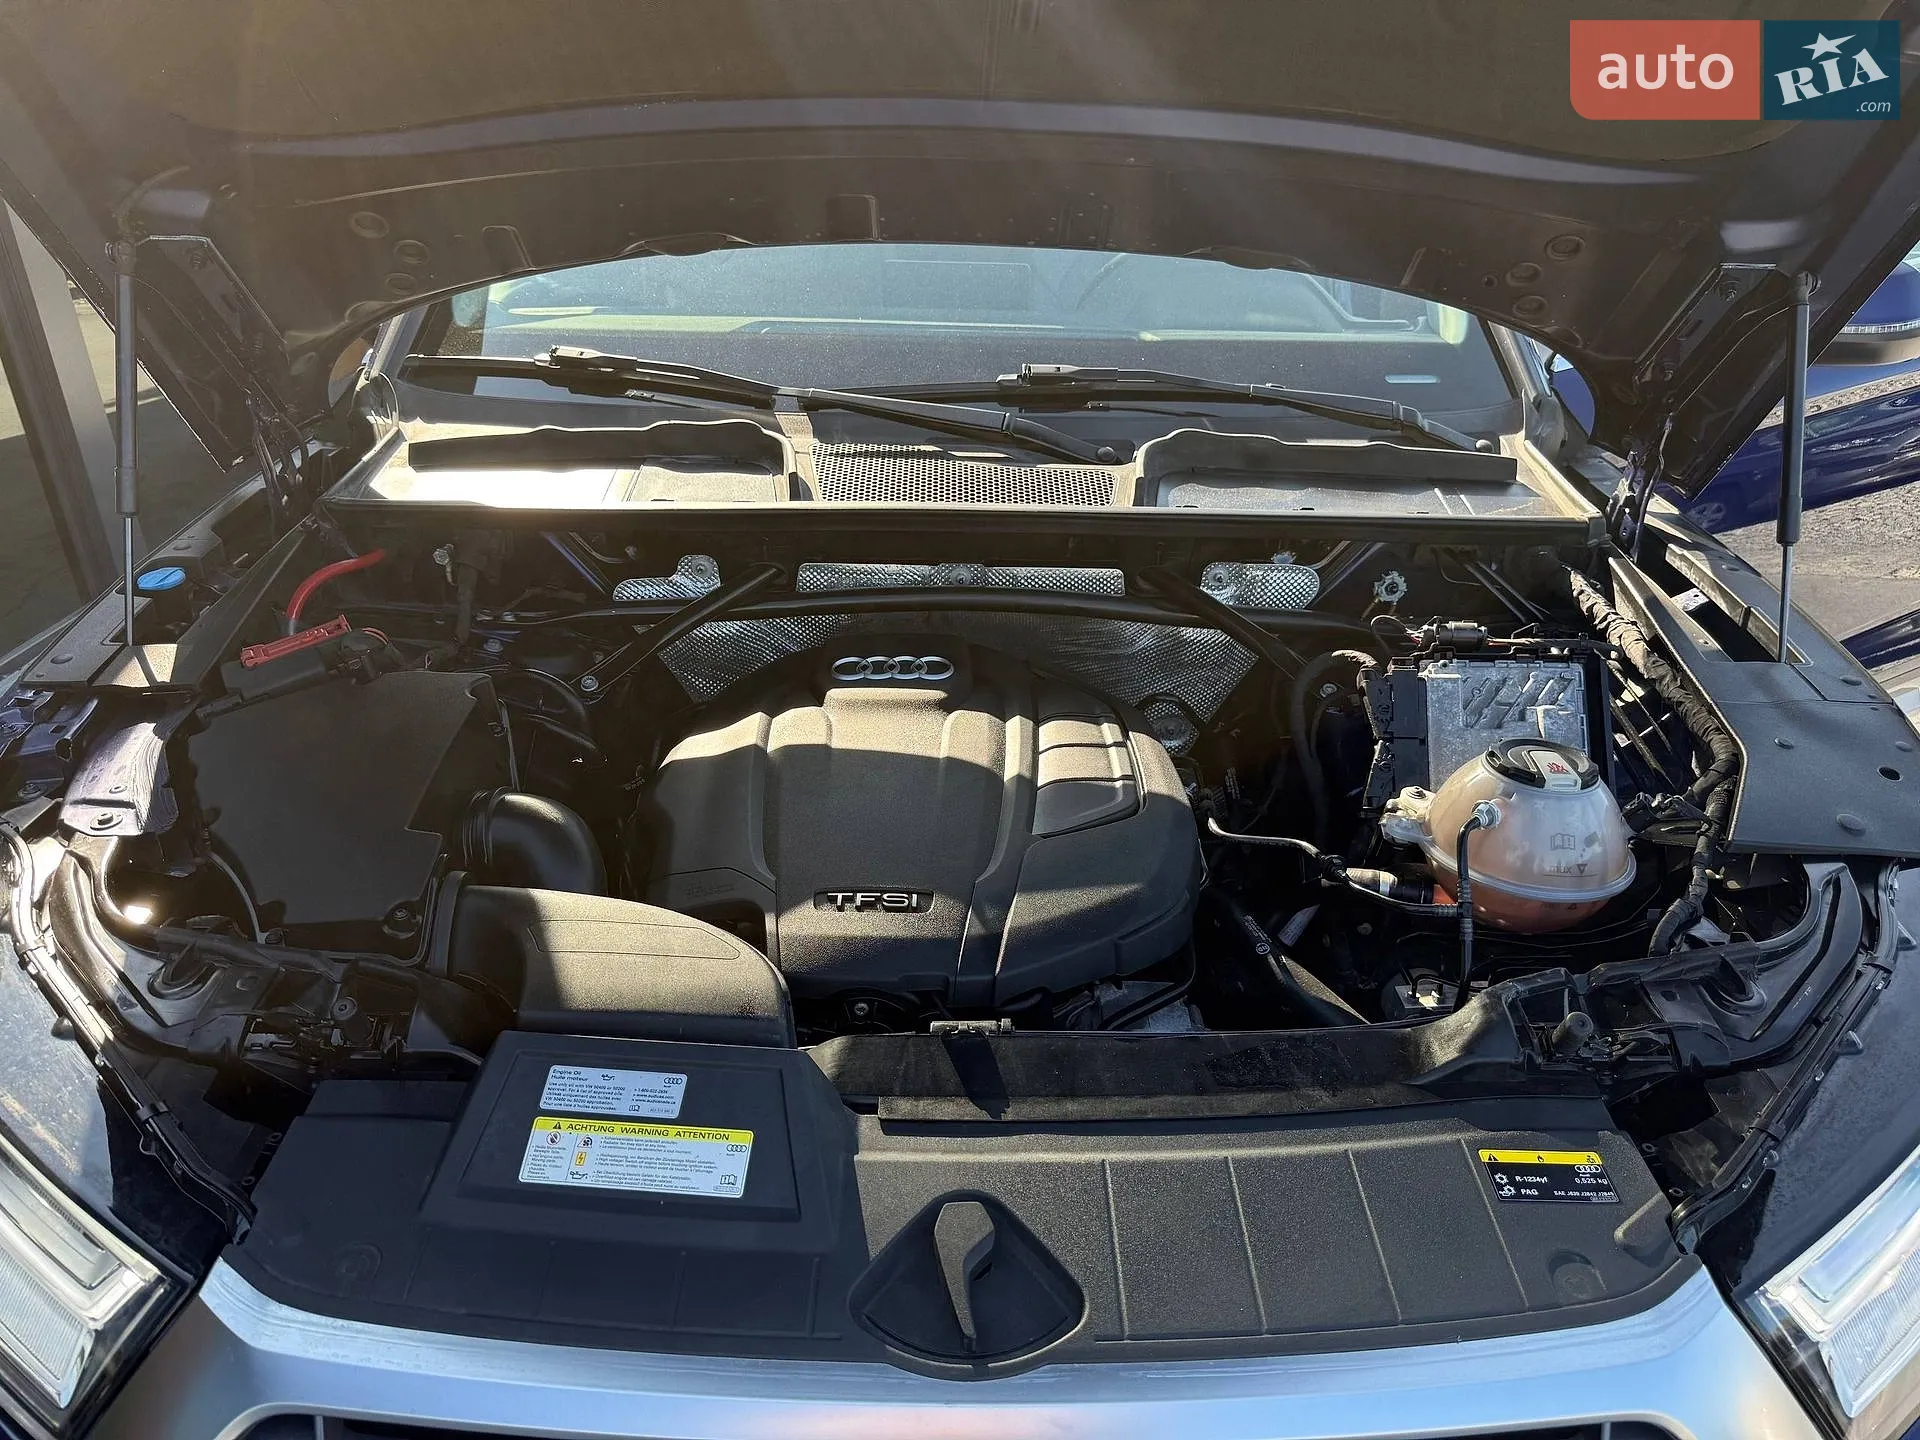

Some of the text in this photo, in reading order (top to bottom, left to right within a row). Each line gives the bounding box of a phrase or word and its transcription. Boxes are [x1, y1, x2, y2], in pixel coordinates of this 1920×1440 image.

[827, 892, 918, 908] TFSI
[566, 1123, 730, 1140] ACHTUNG WARNING ATTENTION
[1597, 1177, 1608, 1185] kg
